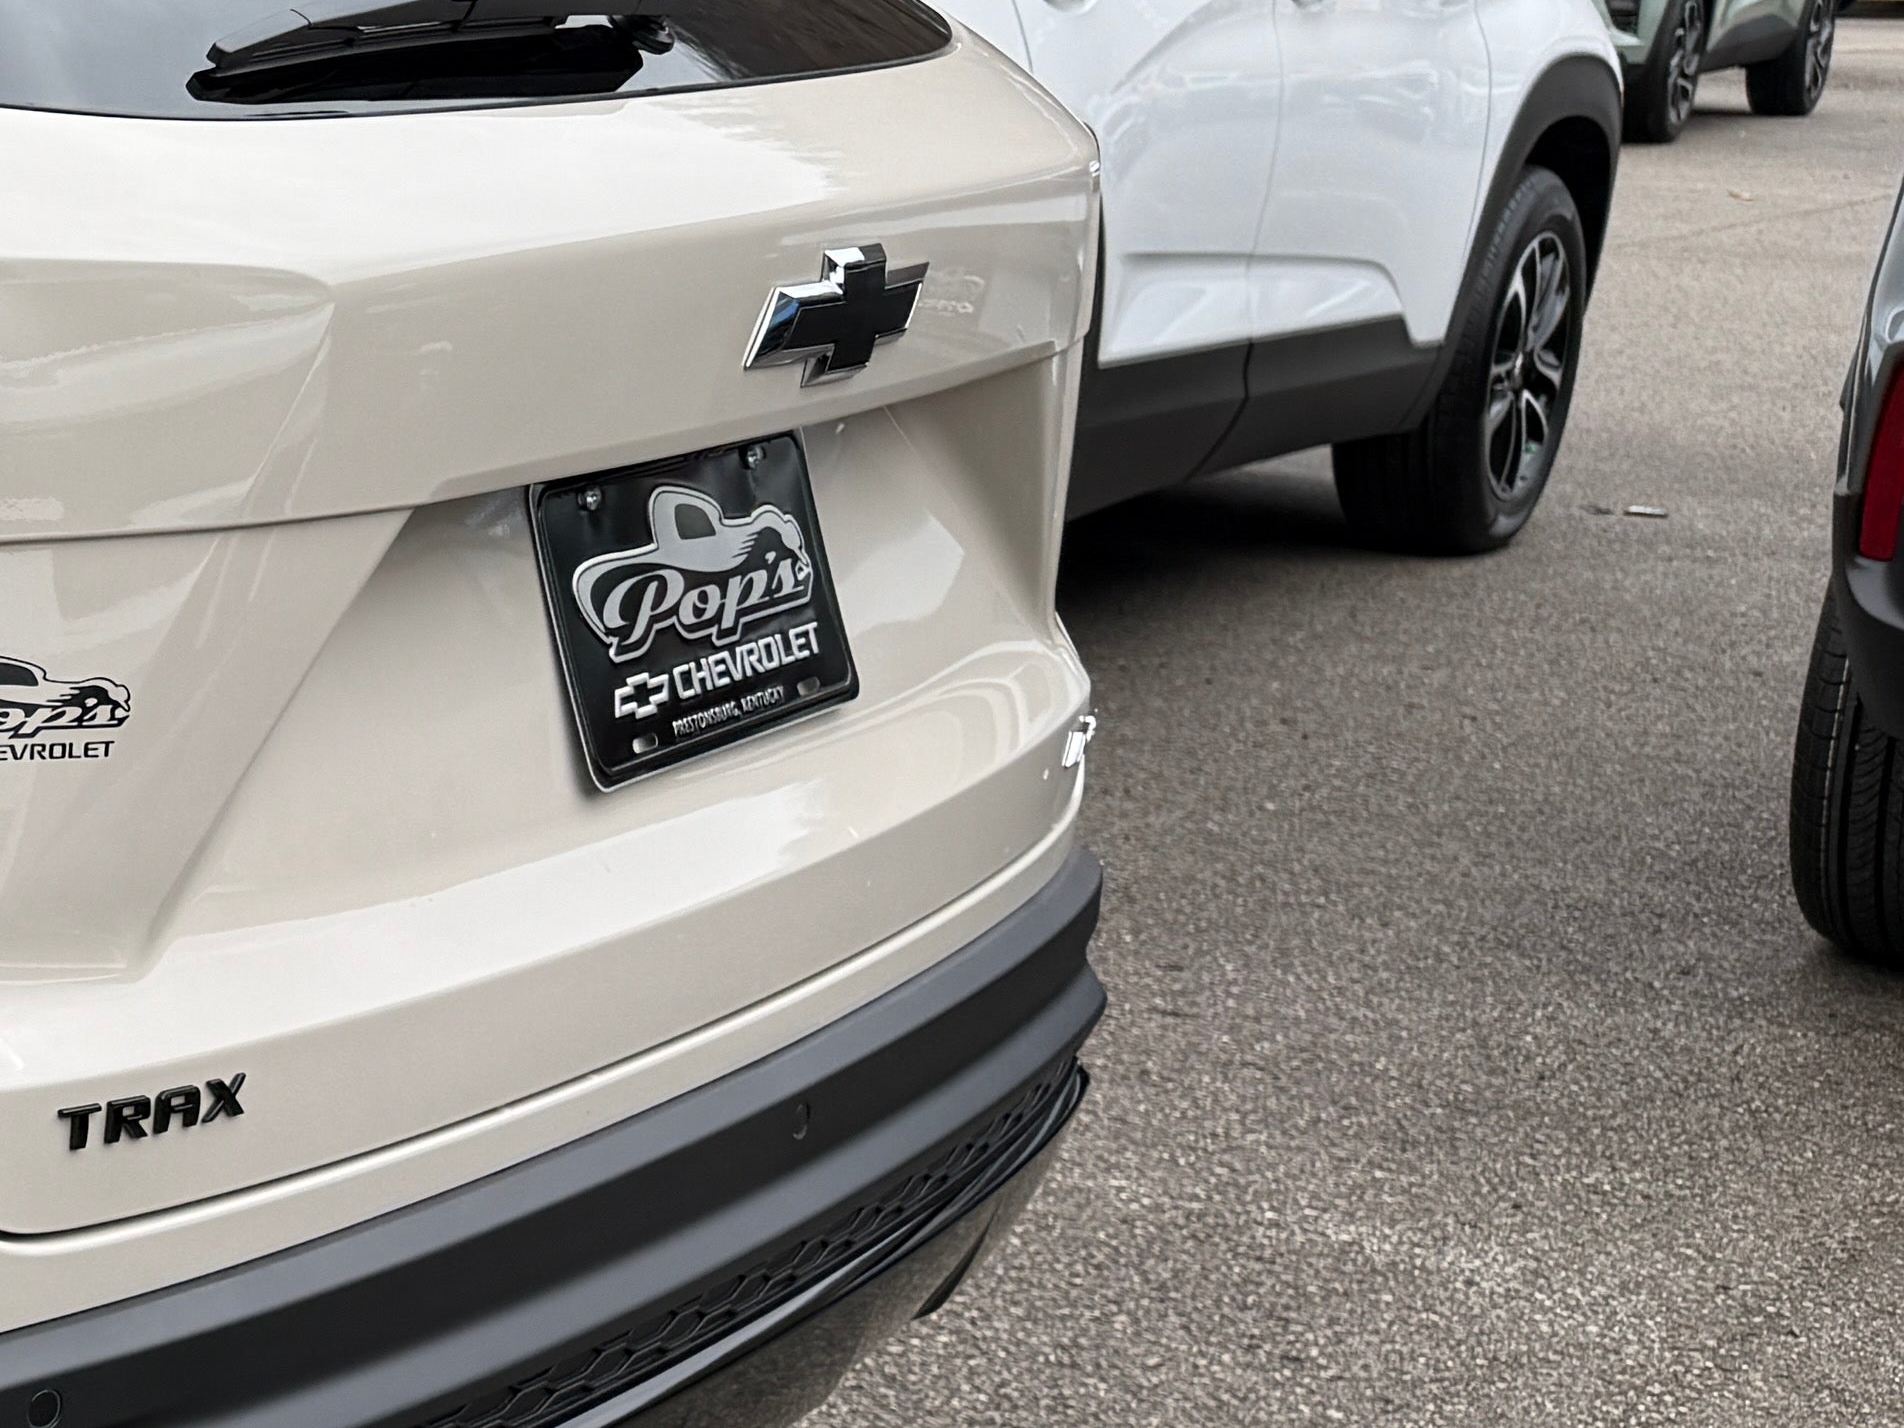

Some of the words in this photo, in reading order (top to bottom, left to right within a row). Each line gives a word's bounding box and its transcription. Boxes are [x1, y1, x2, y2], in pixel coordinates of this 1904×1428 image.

[603, 551, 804, 645] Pop's
[673, 622, 819, 700] CHEVROLET
[672, 701, 741, 737] PRESTONSBURG,
[741, 685, 784, 713] KENTUCKY
[57, 1072, 246, 1150] TRAX
